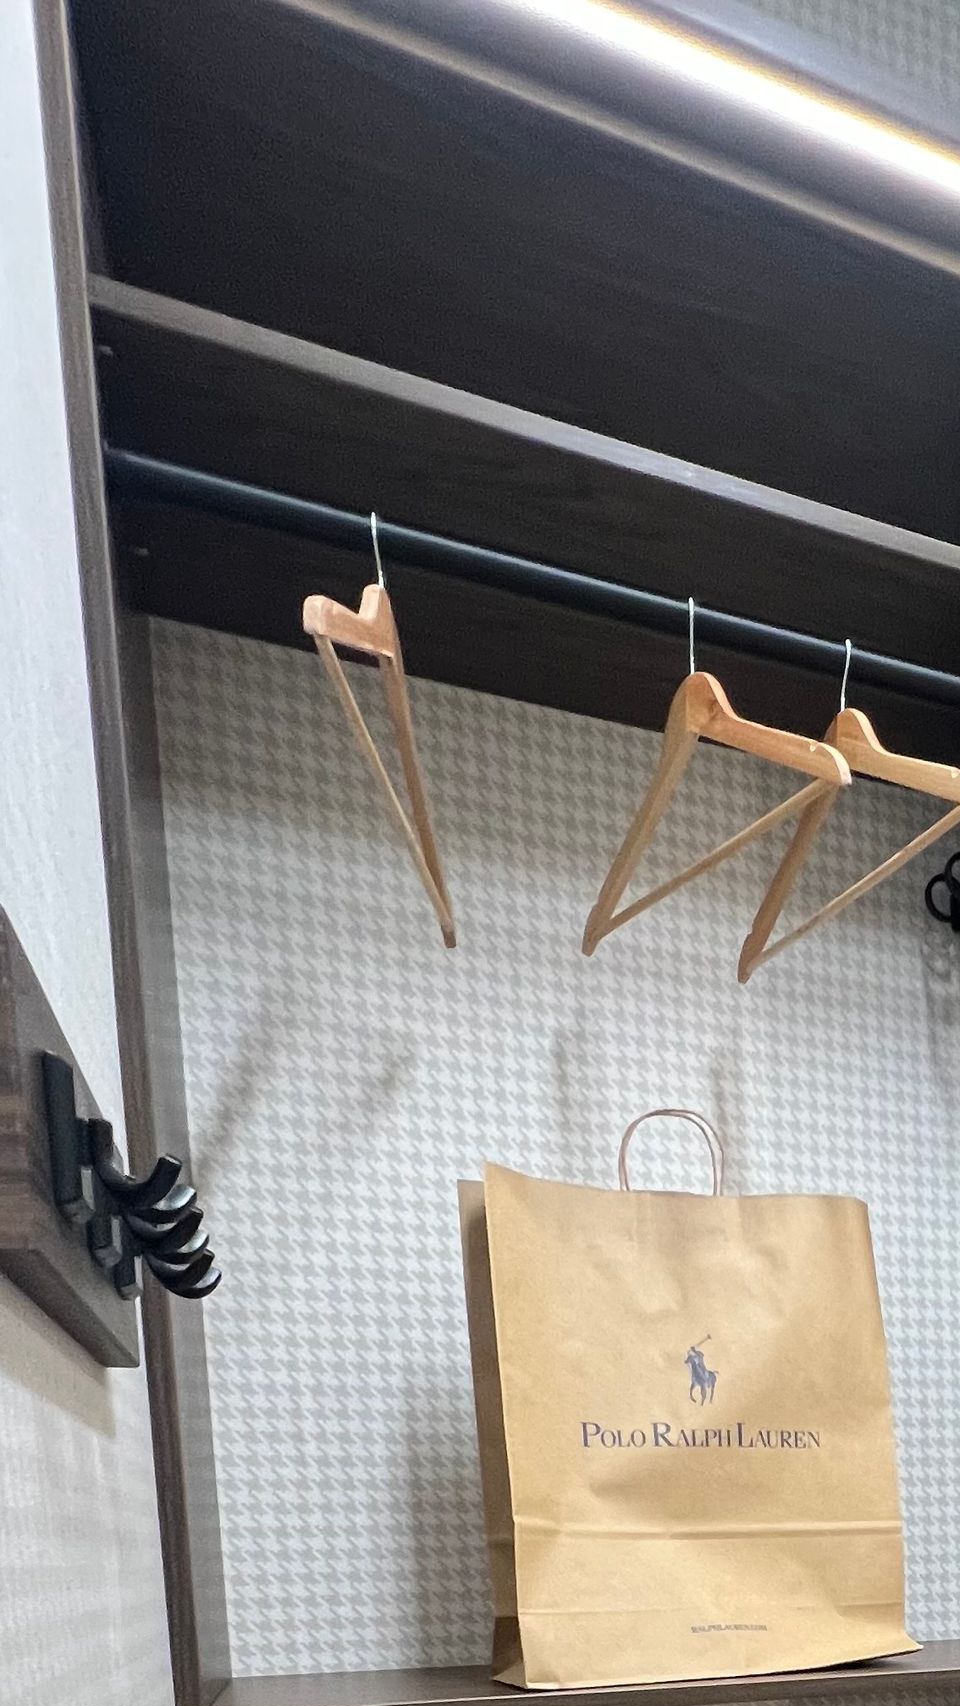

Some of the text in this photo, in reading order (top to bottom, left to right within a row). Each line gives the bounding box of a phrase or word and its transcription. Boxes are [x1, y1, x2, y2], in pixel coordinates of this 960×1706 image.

[580, 1422, 820, 1448] POLO RALPH LAUREN
